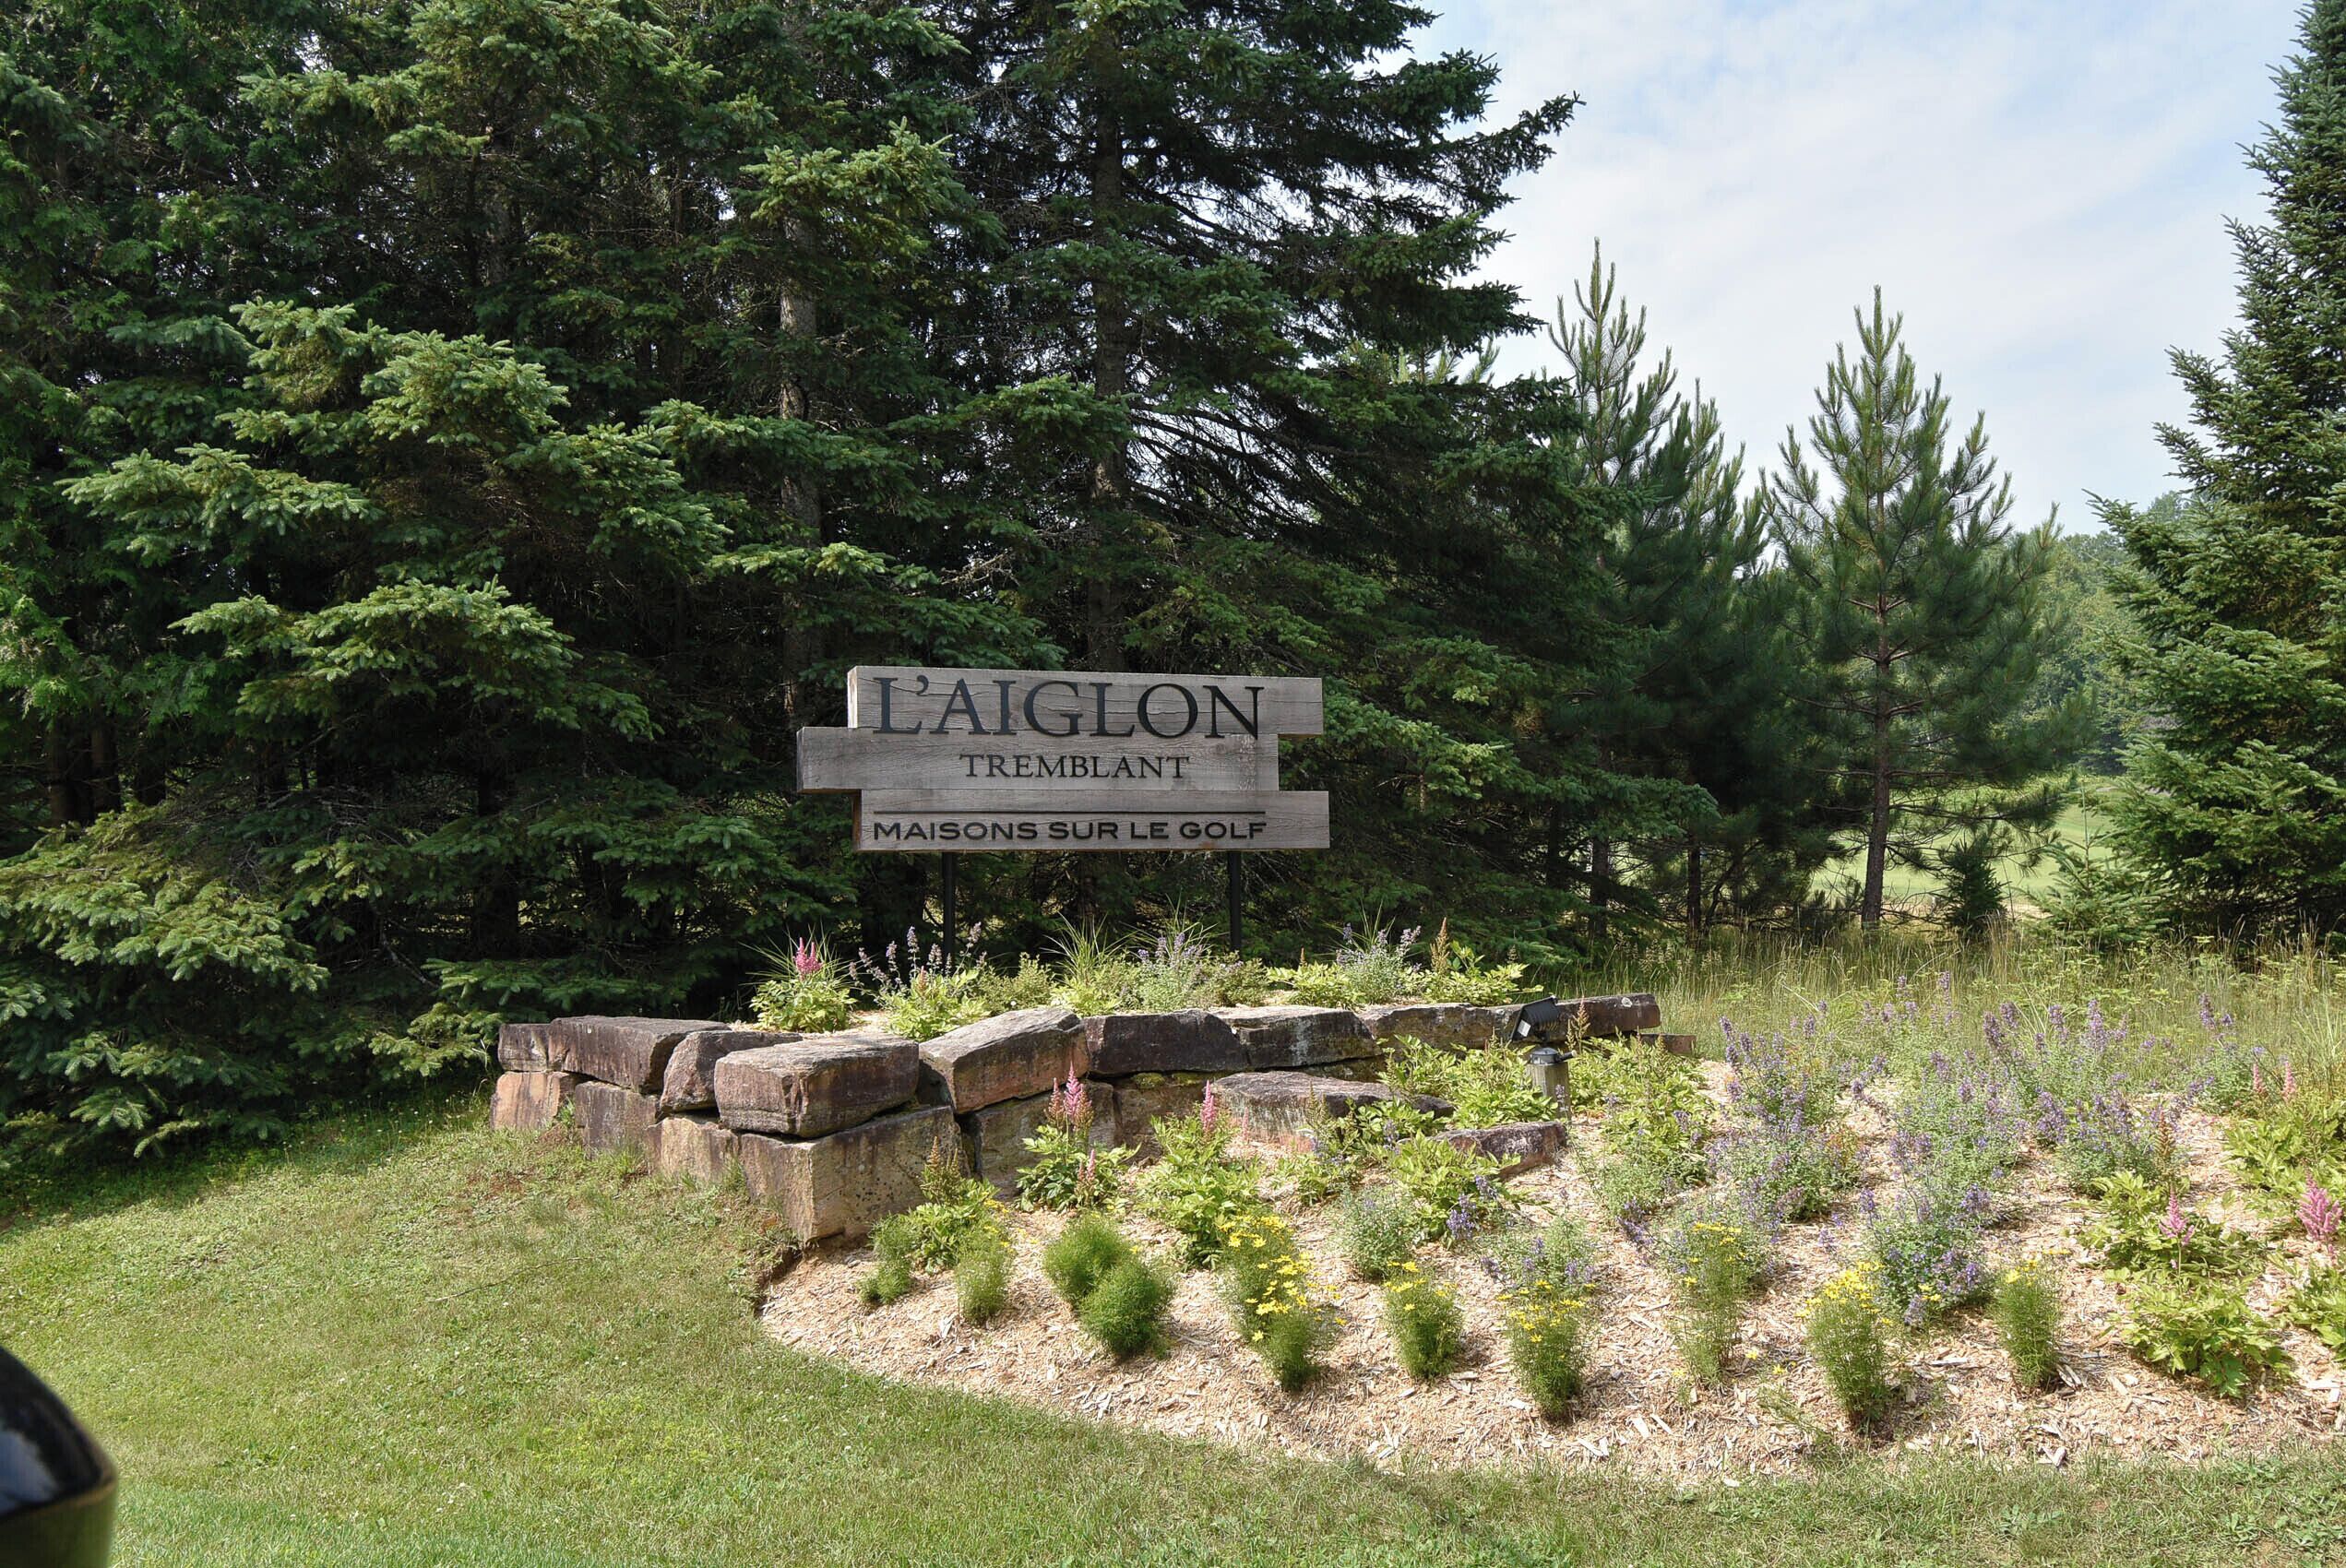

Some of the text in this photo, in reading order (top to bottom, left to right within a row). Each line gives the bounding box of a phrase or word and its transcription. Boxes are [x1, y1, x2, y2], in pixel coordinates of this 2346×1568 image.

[959, 754, 1190, 779] TREMBLANT
[873, 821, 1267, 840] MAISONS SUR LE GOLF
